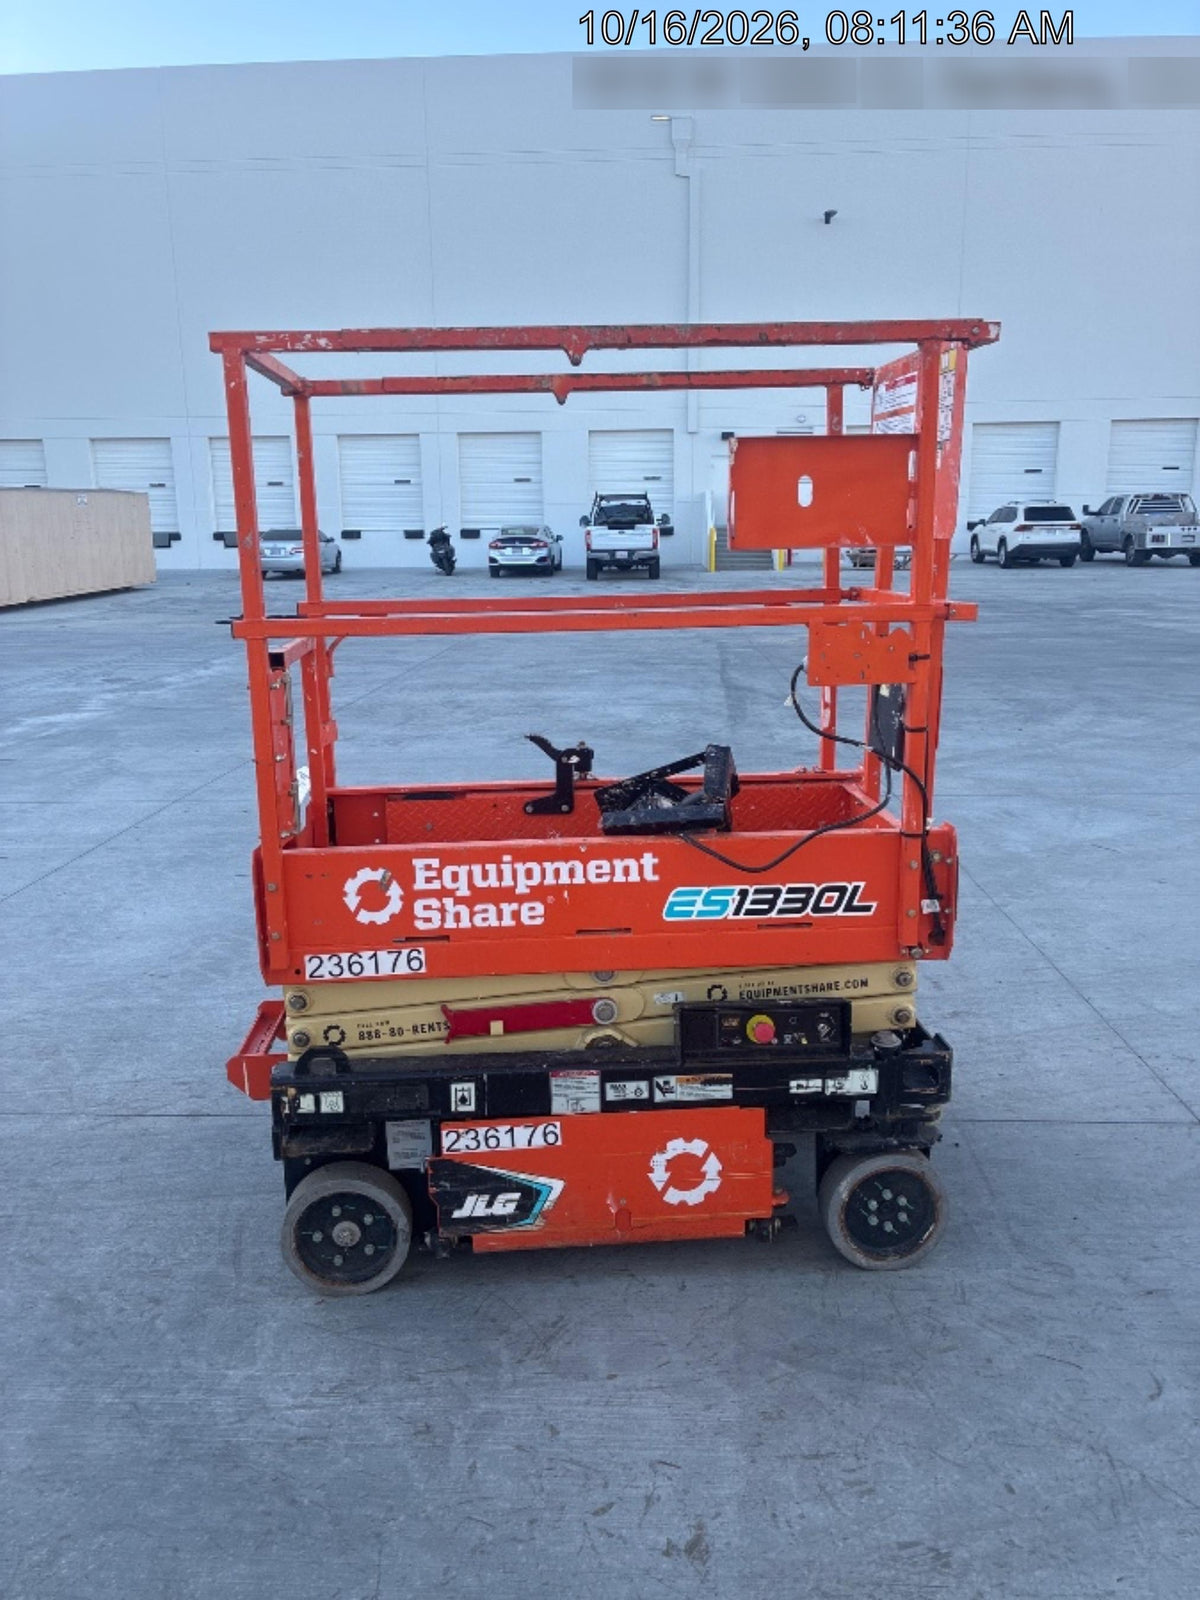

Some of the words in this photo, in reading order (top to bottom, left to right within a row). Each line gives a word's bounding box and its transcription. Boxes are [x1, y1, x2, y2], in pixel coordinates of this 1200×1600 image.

[412, 852, 660, 897] Equipment
[413, 897, 545, 930] Share
[663, 881, 877, 921] ES1330L
[307, 949, 424, 978] 236176
[444, 1122, 560, 1152] 236176
[451, 1192, 521, 1219] JLG
